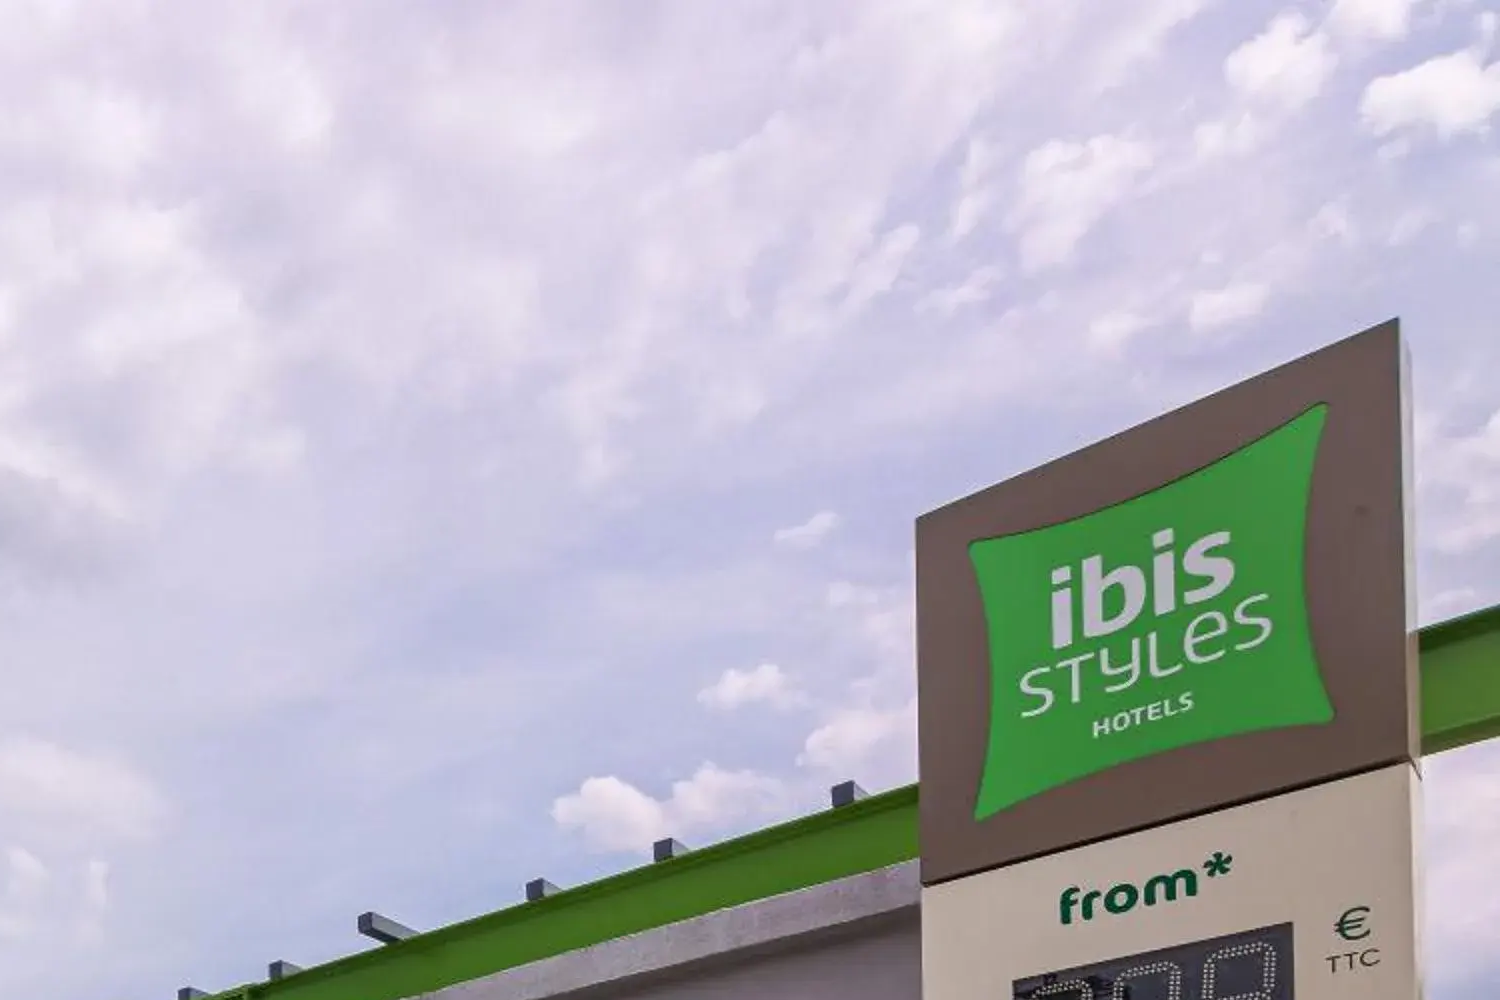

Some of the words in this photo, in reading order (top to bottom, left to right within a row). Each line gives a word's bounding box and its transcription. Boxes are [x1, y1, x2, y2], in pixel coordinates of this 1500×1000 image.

[1051, 527, 1235, 650] ibis
[1093, 691, 1194, 738] HOTELS
[1325, 947, 1381, 974] TTC
